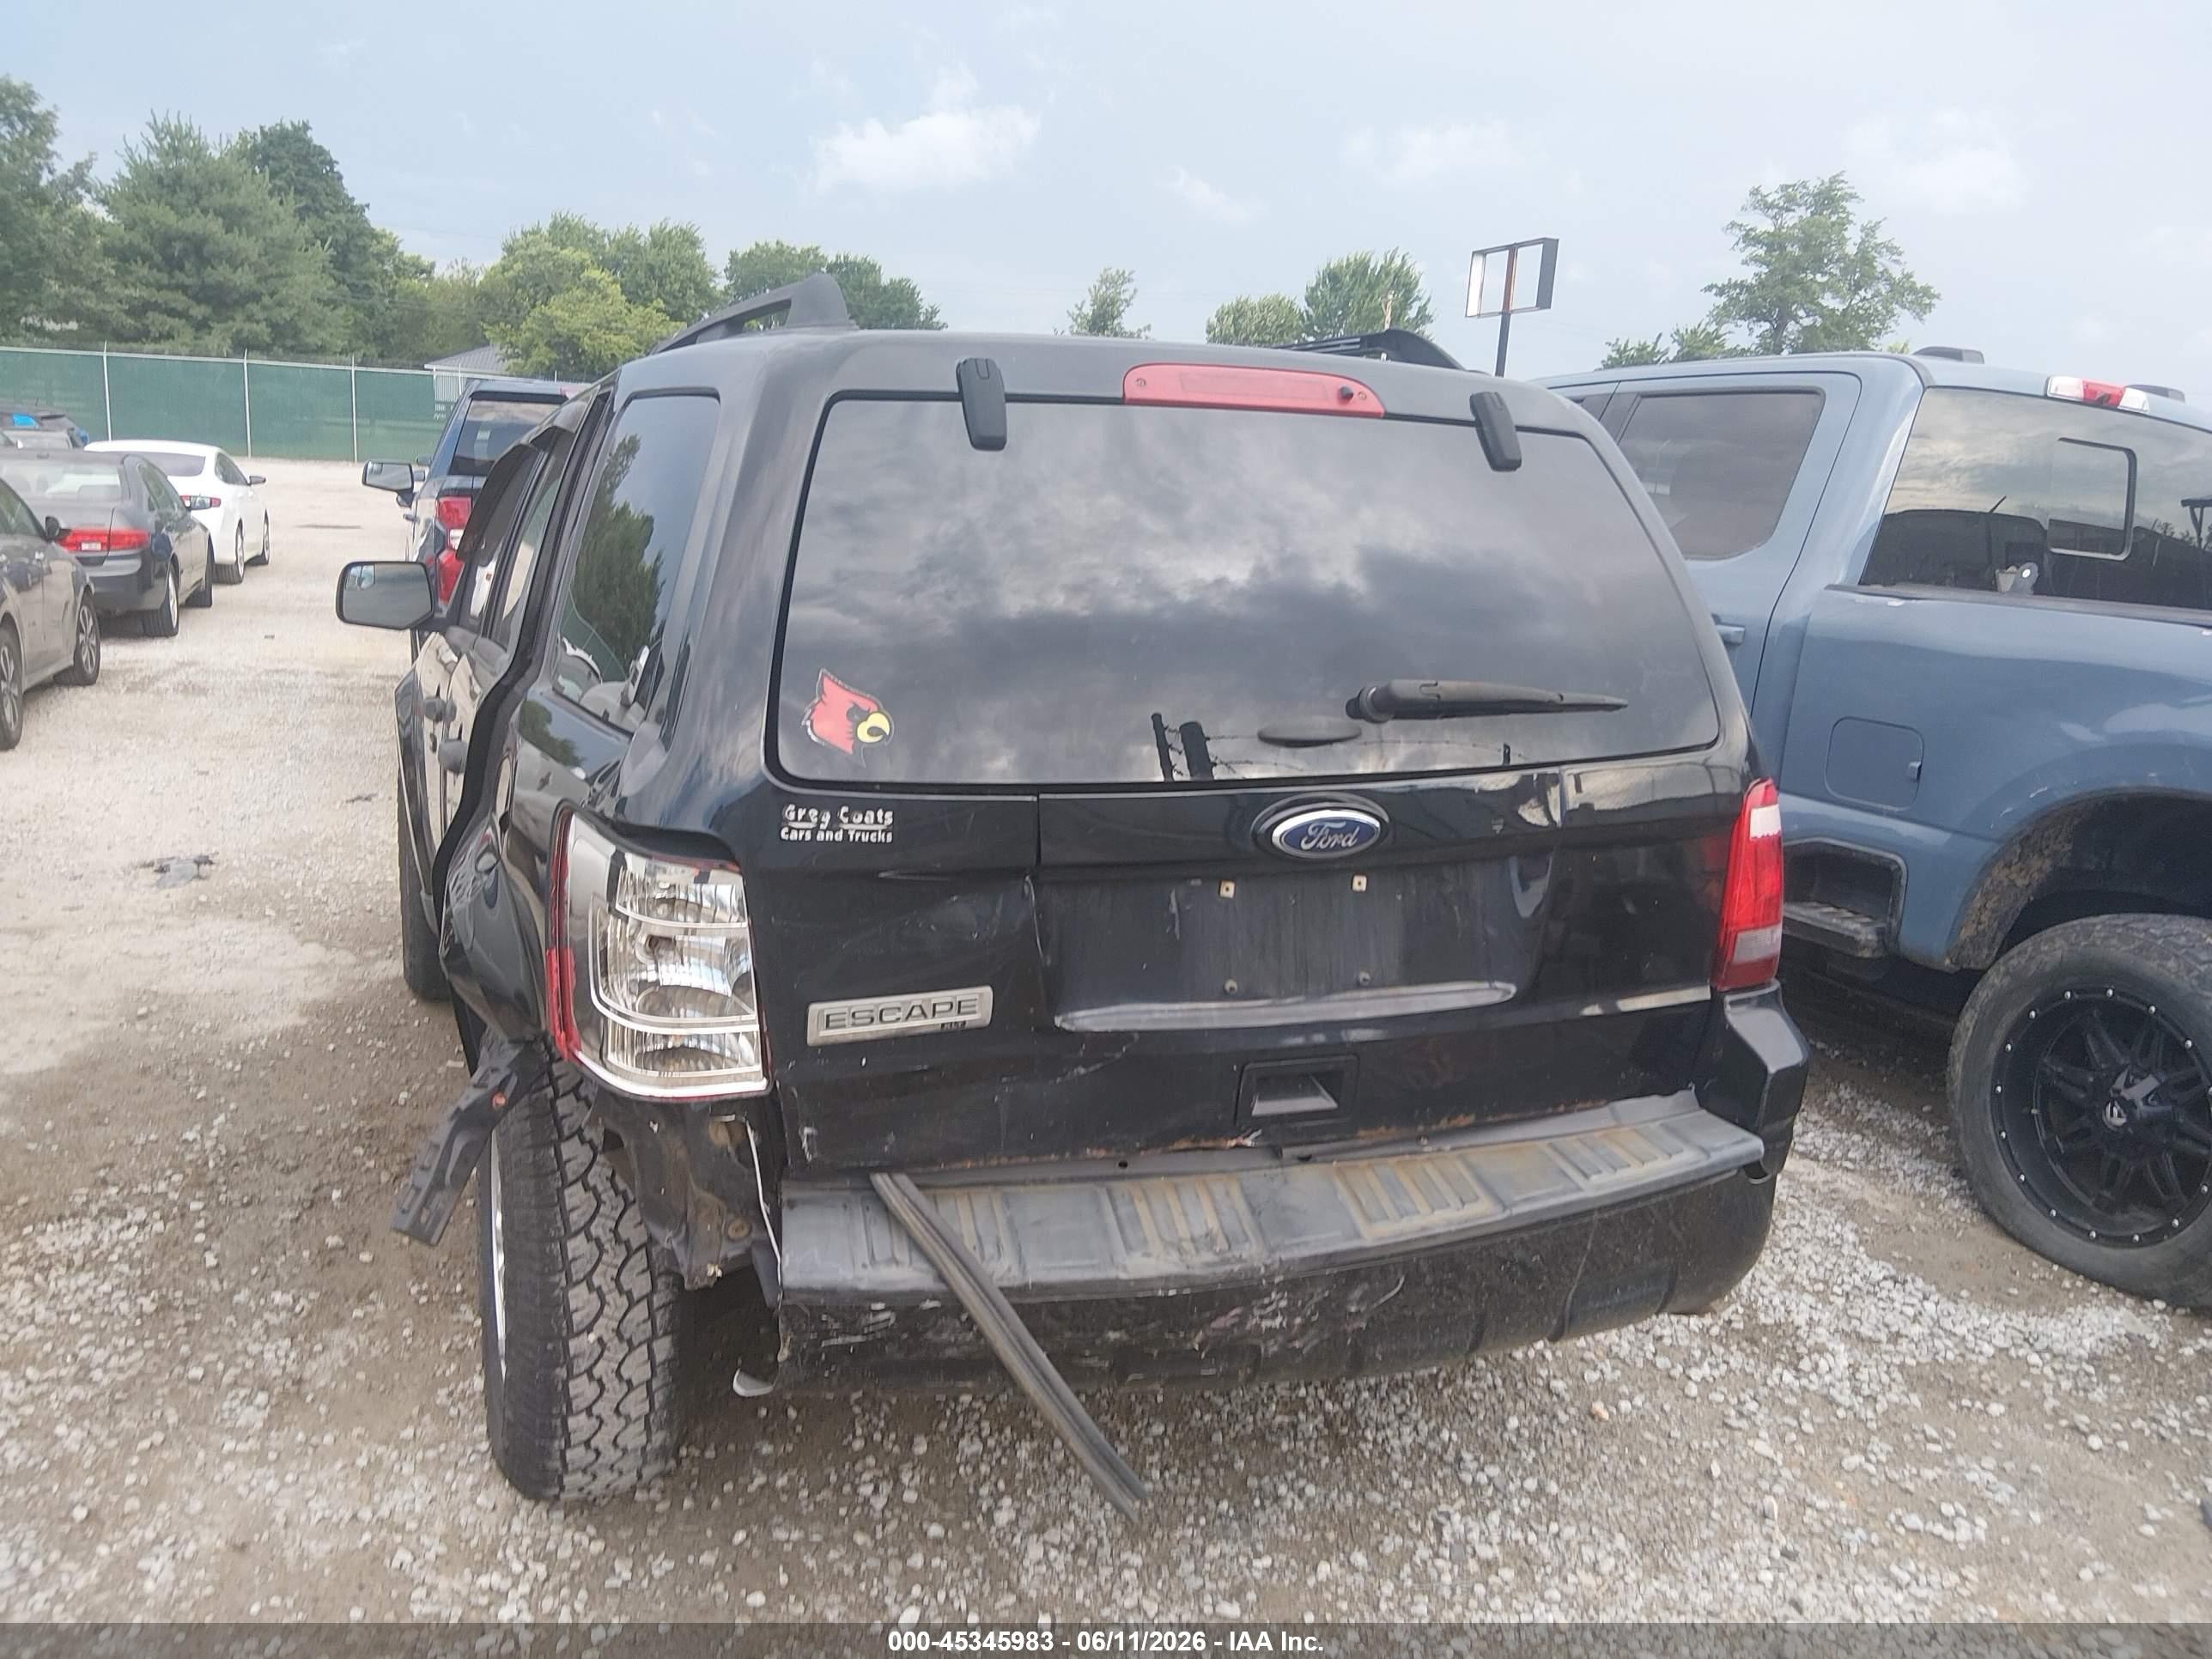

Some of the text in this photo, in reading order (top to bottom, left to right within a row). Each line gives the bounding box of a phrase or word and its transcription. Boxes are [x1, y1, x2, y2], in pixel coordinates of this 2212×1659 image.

[784, 804, 893, 830] Greg Coats
[781, 827, 893, 843] Cars and Trucks
[1300, 821, 1360, 850] Ford
[823, 995, 979, 1030] ESCAPE
